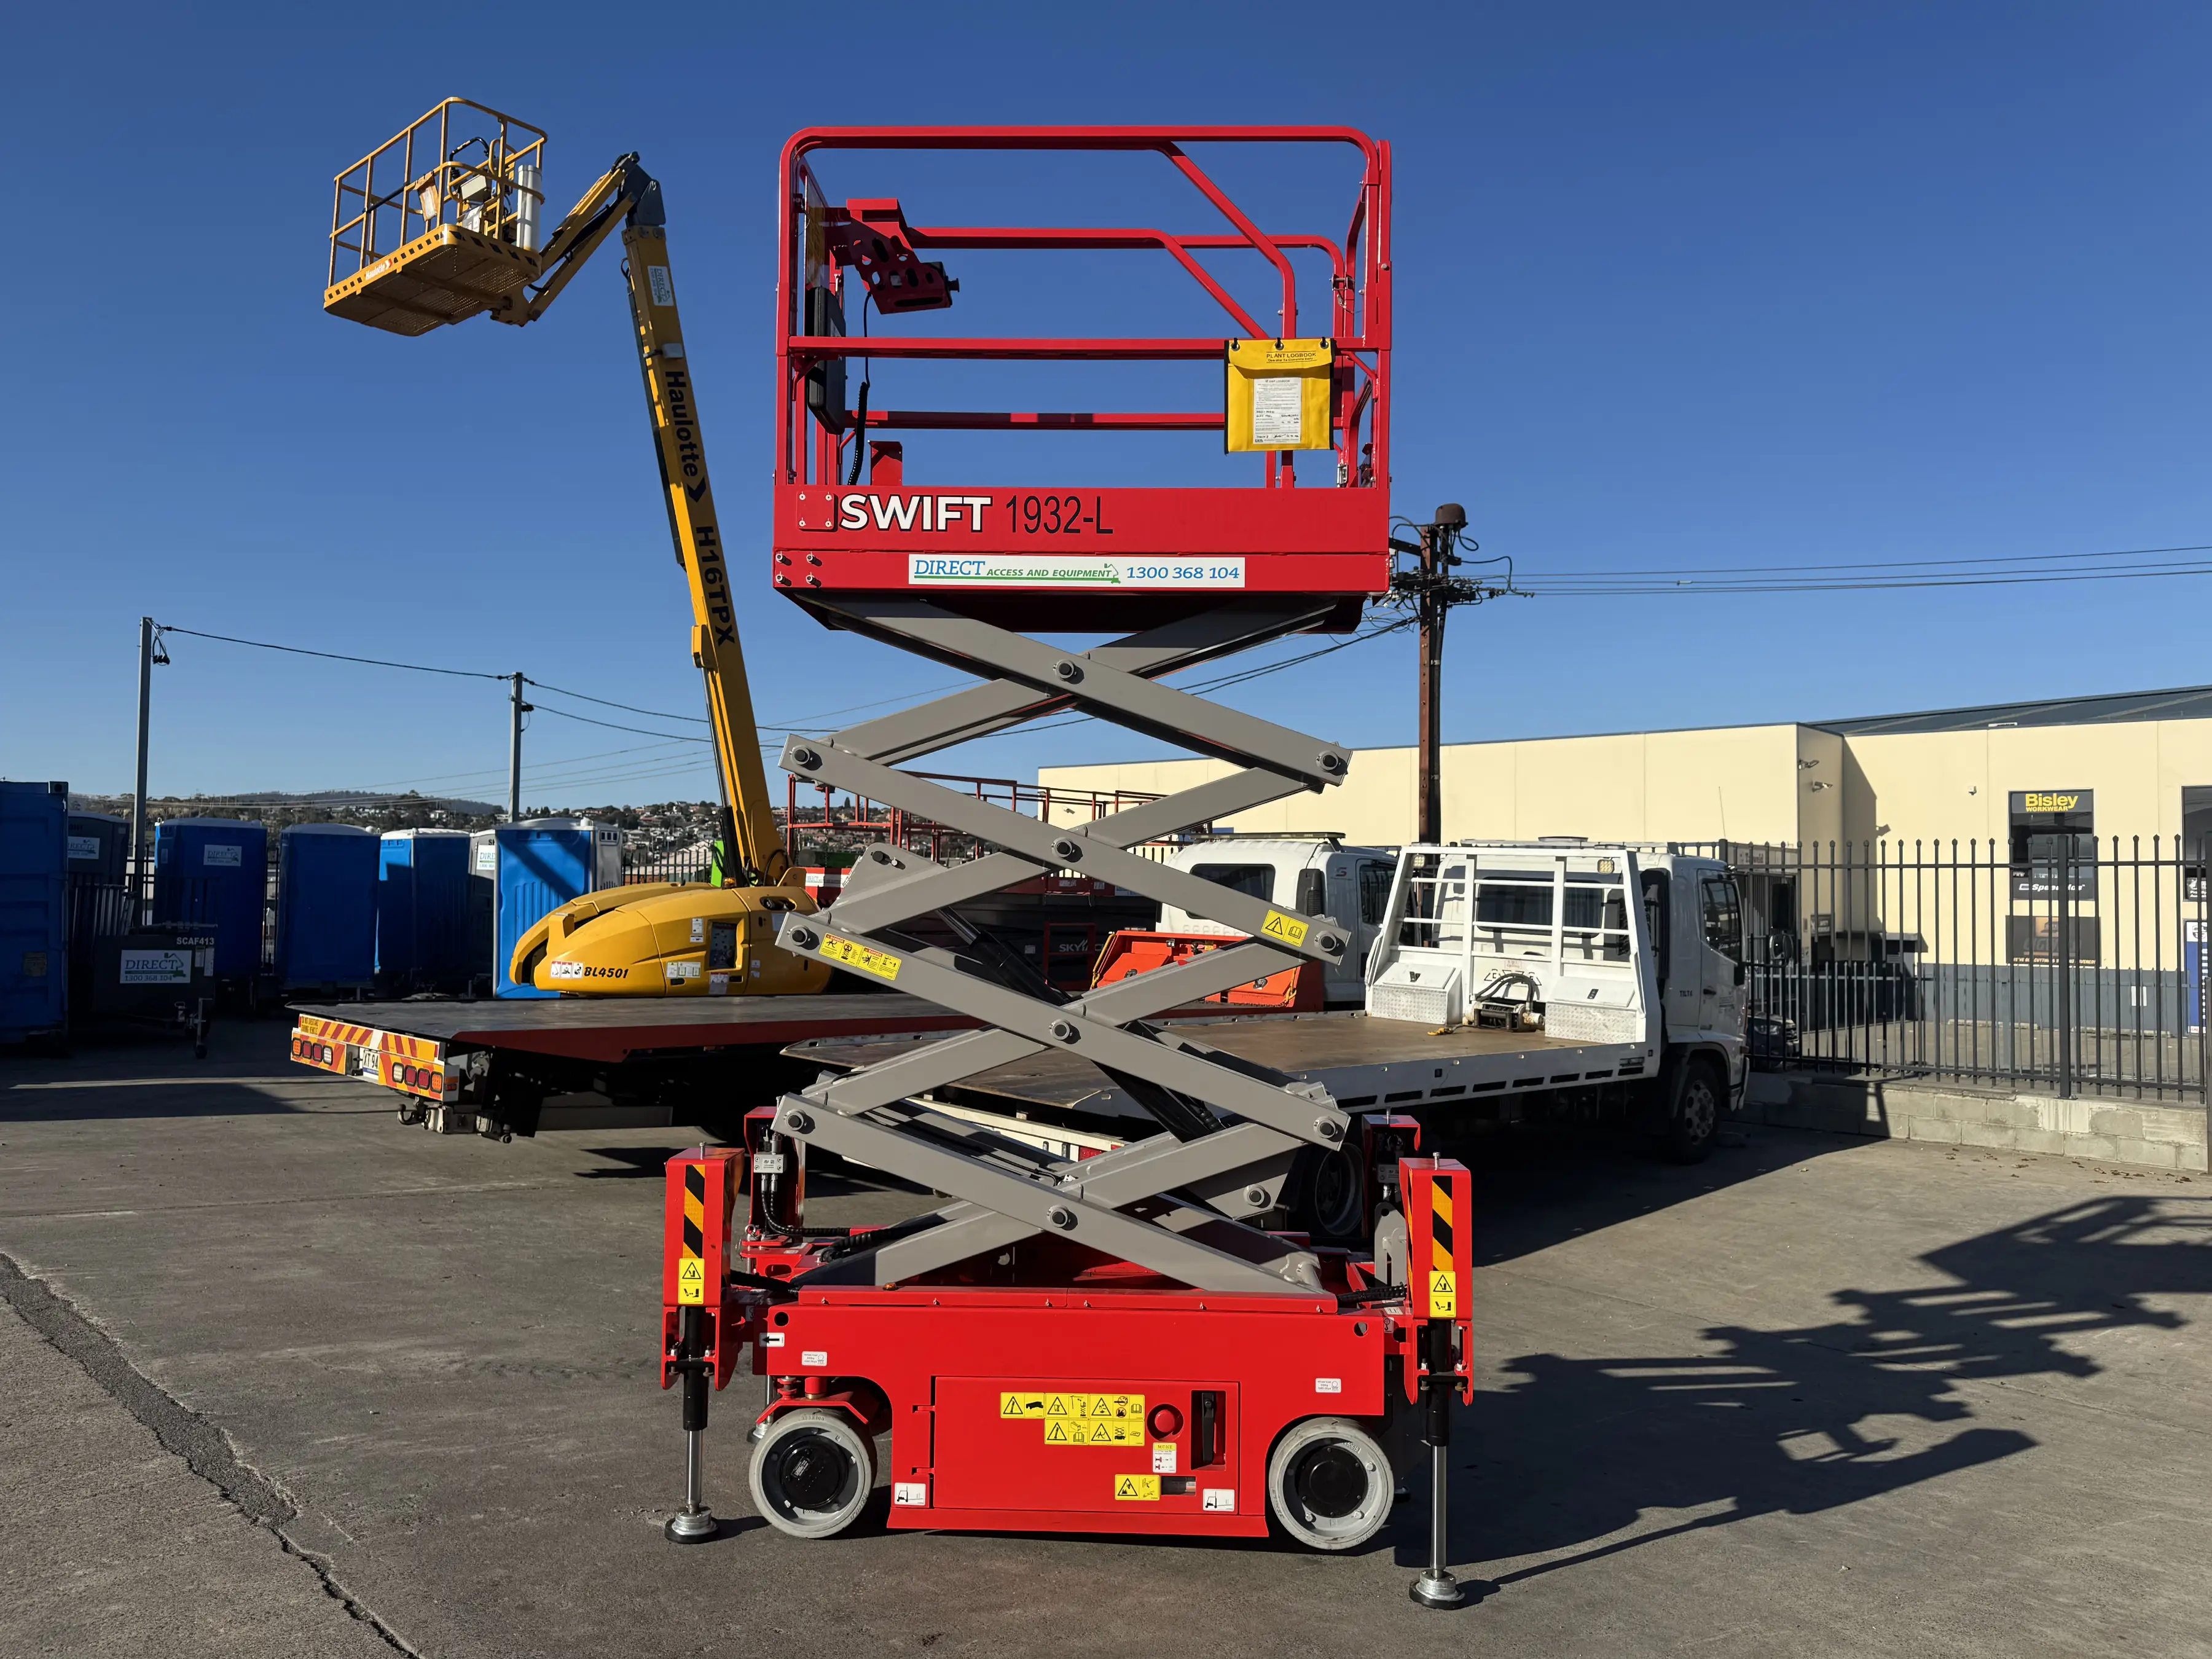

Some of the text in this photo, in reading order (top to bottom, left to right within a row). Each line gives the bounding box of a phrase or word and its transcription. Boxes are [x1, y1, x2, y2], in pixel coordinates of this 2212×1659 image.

[665, 371, 699, 477] Haulotte
[839, 493, 1113, 534] SWIFT 1932-L
[914, 560, 986, 576] DIRECT
[1052, 569, 1112, 578] EQUIPMENT
[1127, 567, 1169, 579] 1300
[1172, 567, 1203, 579] 368
[1209, 567, 1239, 579] 104
[696, 526, 735, 646] H16TPX
[2025, 793, 2079, 809] Bisley
[125, 959, 178, 970] DIRECT
[584, 967, 629, 979] BL4501
